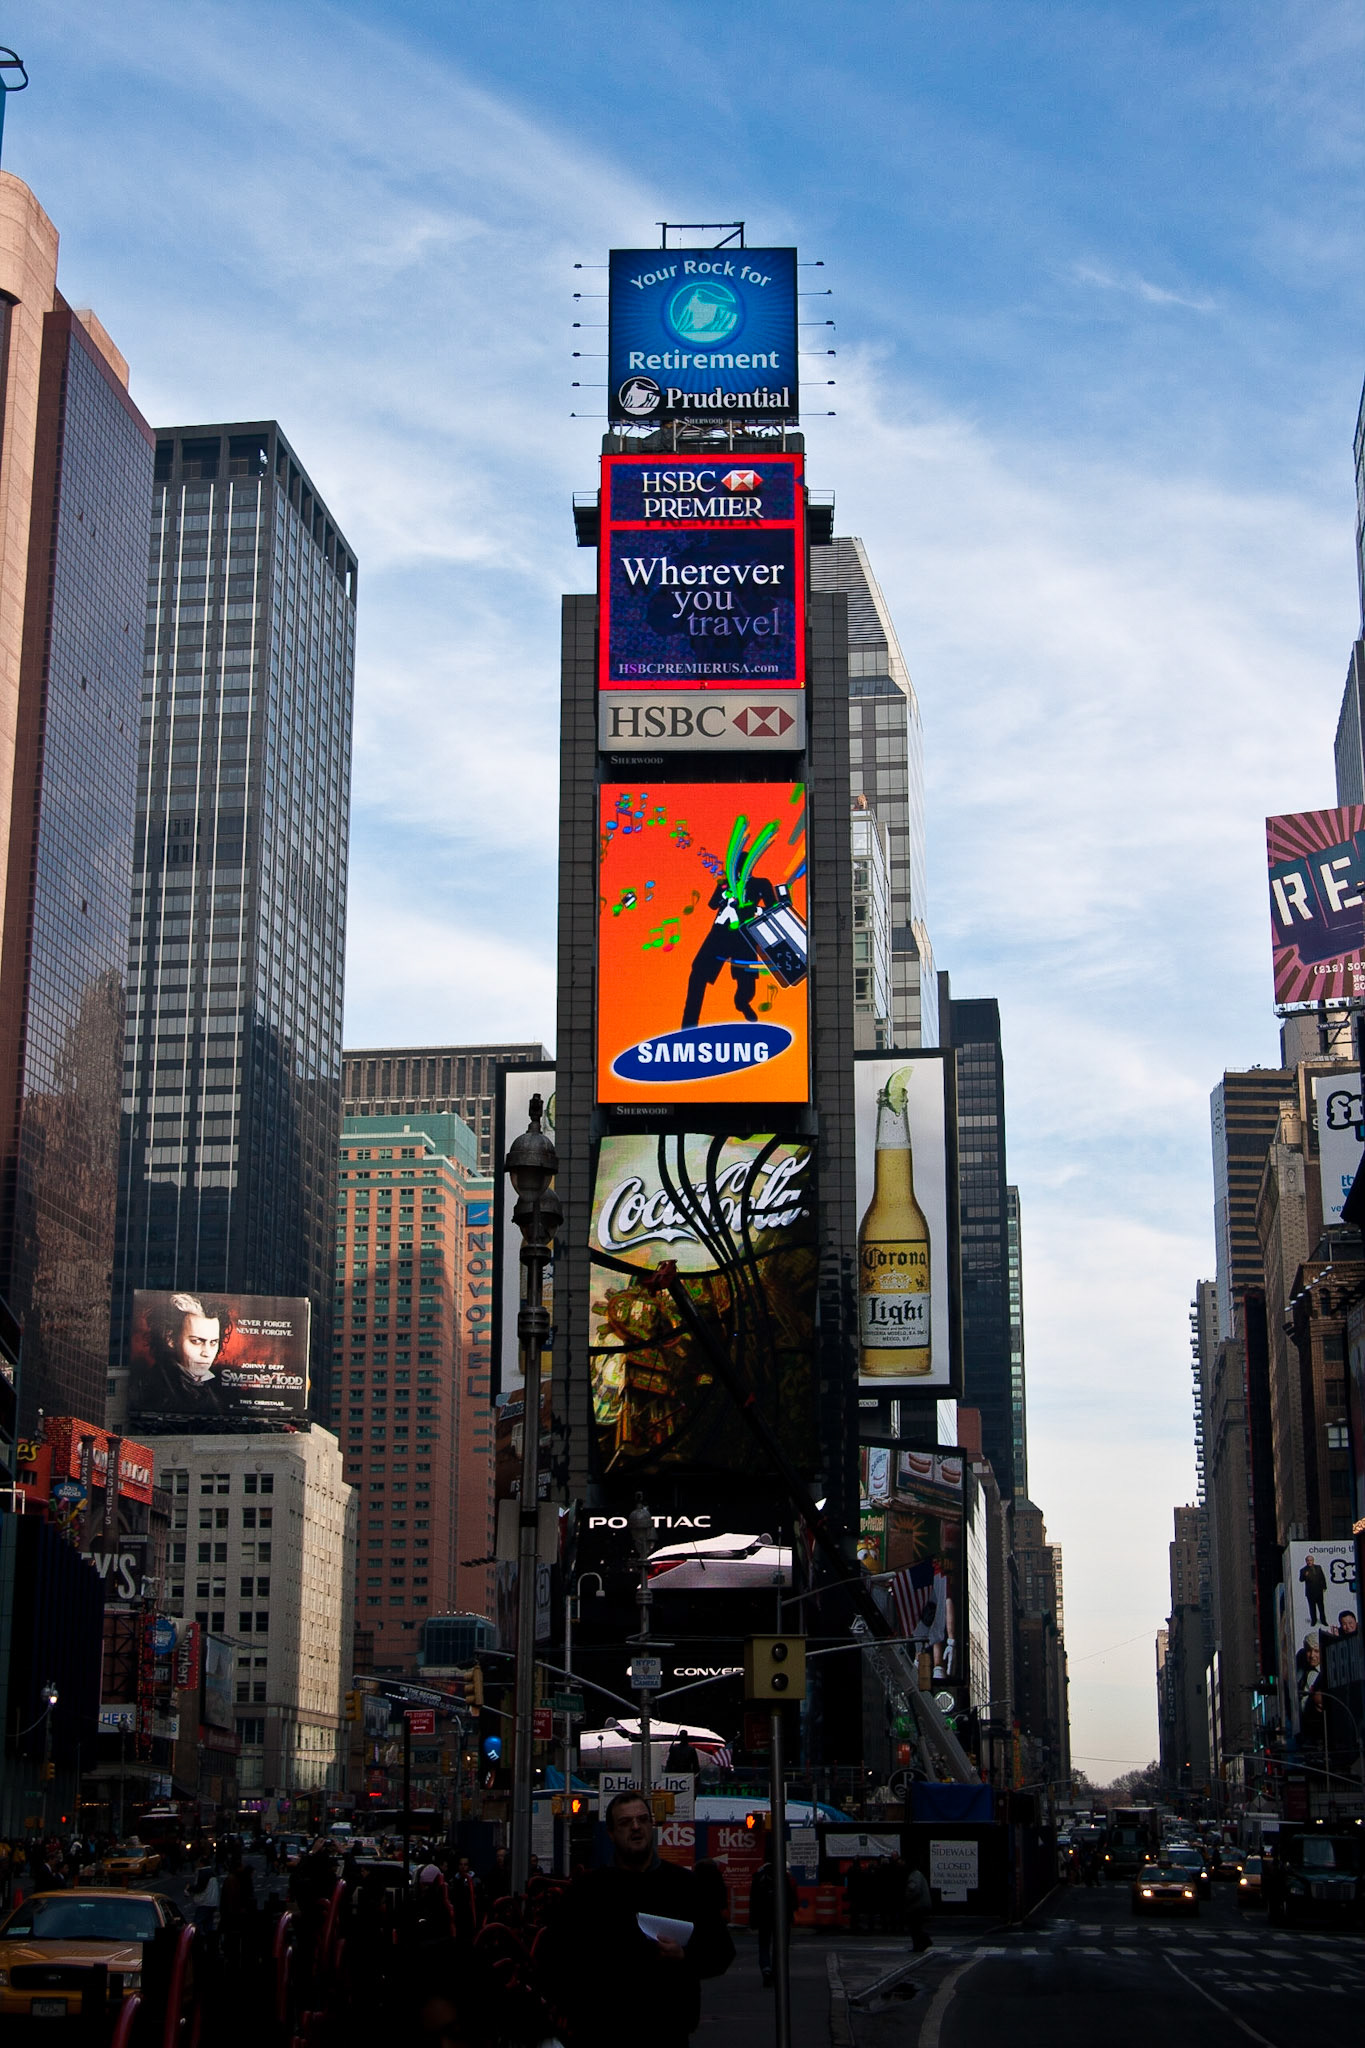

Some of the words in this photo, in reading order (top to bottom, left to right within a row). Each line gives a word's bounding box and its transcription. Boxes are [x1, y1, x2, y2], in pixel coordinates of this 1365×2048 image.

[630, 264, 677, 290] Your
[684, 260, 734, 277] Rock
[740, 265, 772, 288] for
[629, 349, 780, 370] Retirement
[665, 387, 790, 409] Prudential
[641, 470, 716, 493] HSBC
[643, 496, 764, 519] PREMIER
[621, 557, 785, 586] Wherever
[671, 590, 735, 619] you
[687, 607, 783, 637] travel
[608, 706, 727, 738] HSBC
[610, 754, 664, 765] SHERWOOD
[1313, 962, 1344, 976] (212)
[637, 1042, 769, 1064] SAMSUNG
[616, 1106, 668, 1115] SHERWOOD
[863, 1247, 926, 1273] Corona
[466, 1232, 488, 1397] NOVOTEL
[868, 1297, 923, 1326] Light
[236, 1327, 259, 1335] NEVER
[261, 1328, 294, 1337] FORGIVE.
[237, 1319, 261, 1327] NEVER
[263, 1320, 293, 1328] FORGET.
[241, 1362, 267, 1370] JOHNNY
[220, 1369, 275, 1385] SWEENEY
[271, 1372, 304, 1386] TODD
[588, 1515, 712, 1529] POTIAC
[1308, 1545, 1346, 1554] changing
[604, 1777, 615, 1790] D.
[657, 1823, 696, 1847] kts
[717, 1828, 756, 1848] tkts
[931, 1848, 977, 1857] SIDEWALK
[936, 1862, 971, 1871] CLOSED
